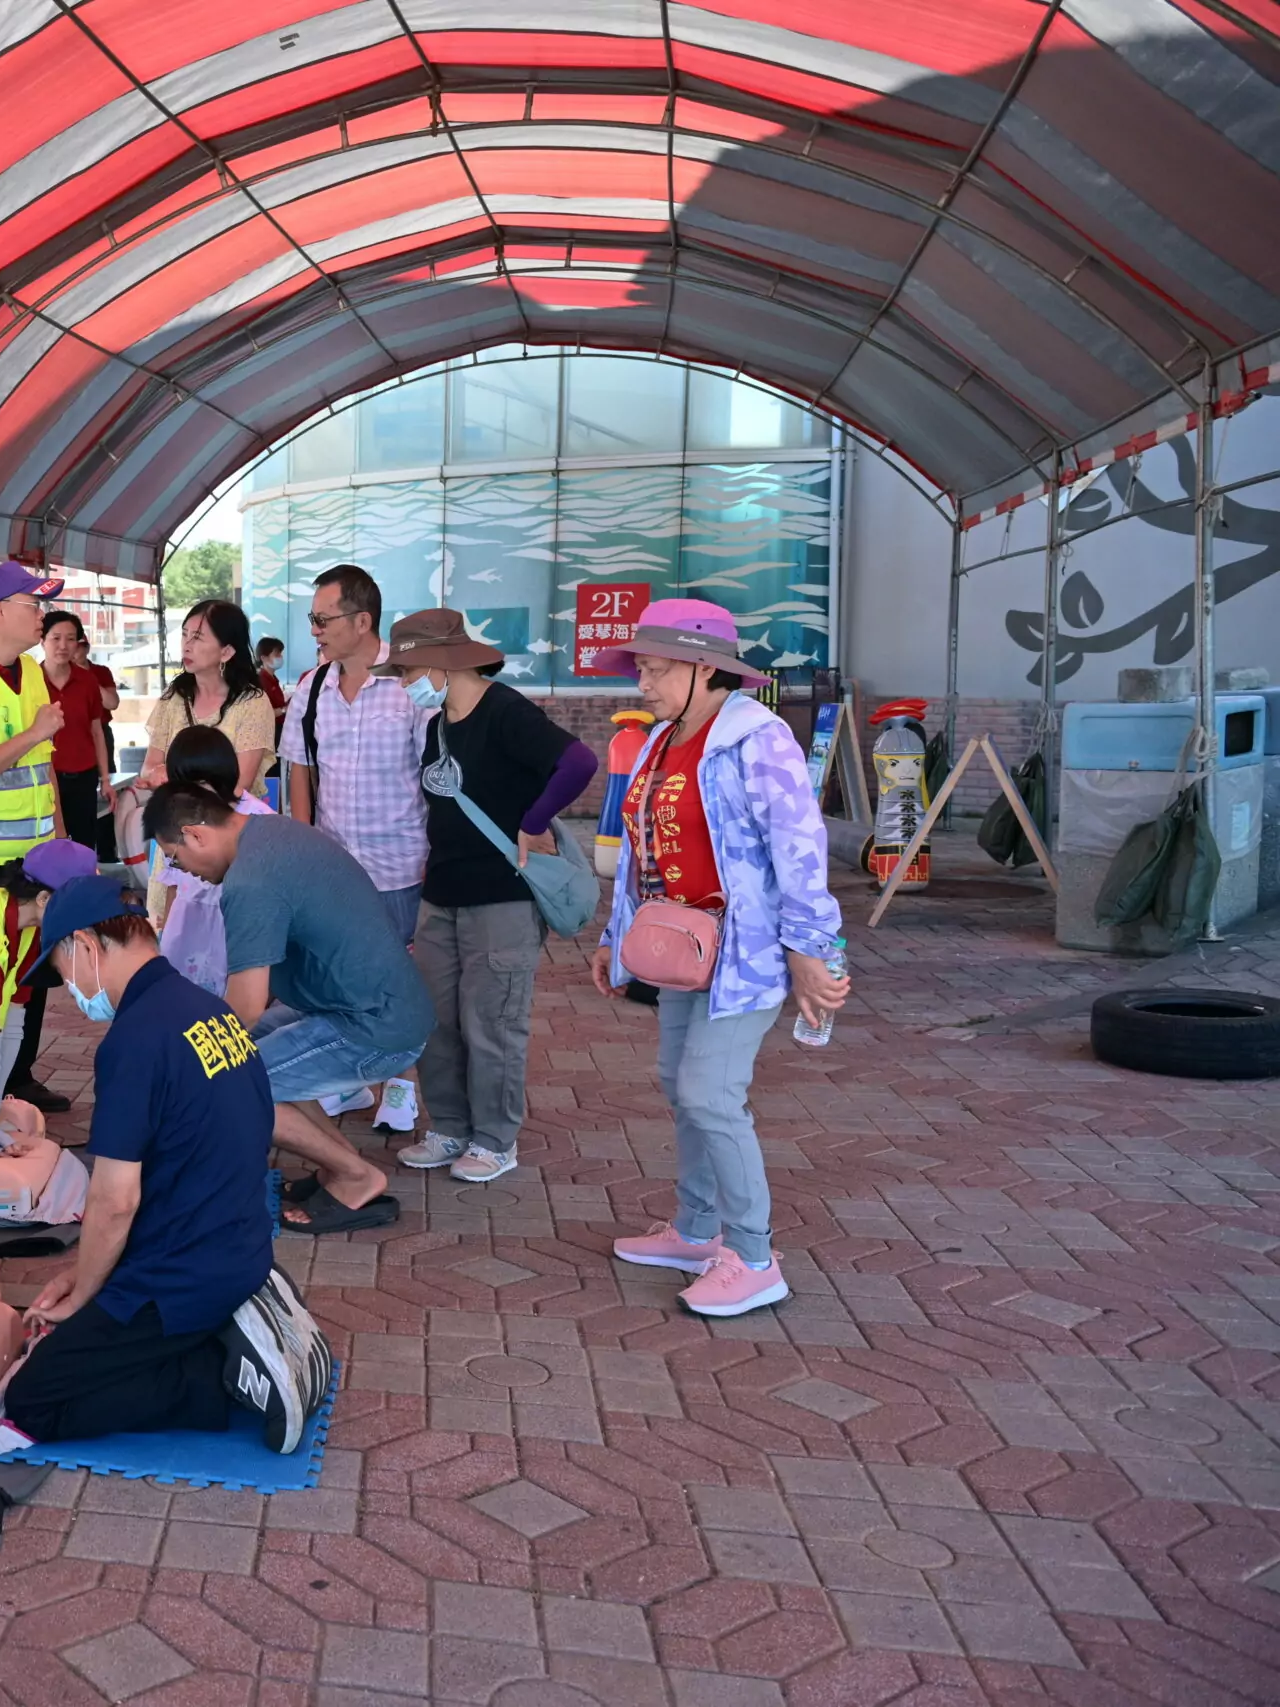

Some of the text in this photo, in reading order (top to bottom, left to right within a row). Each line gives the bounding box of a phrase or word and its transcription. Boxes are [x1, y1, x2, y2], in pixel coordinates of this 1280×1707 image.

[590, 591, 635, 618] 2F
[578, 623, 629, 640] 愛琴海
[182, 1012, 258, 1079] 國強保
